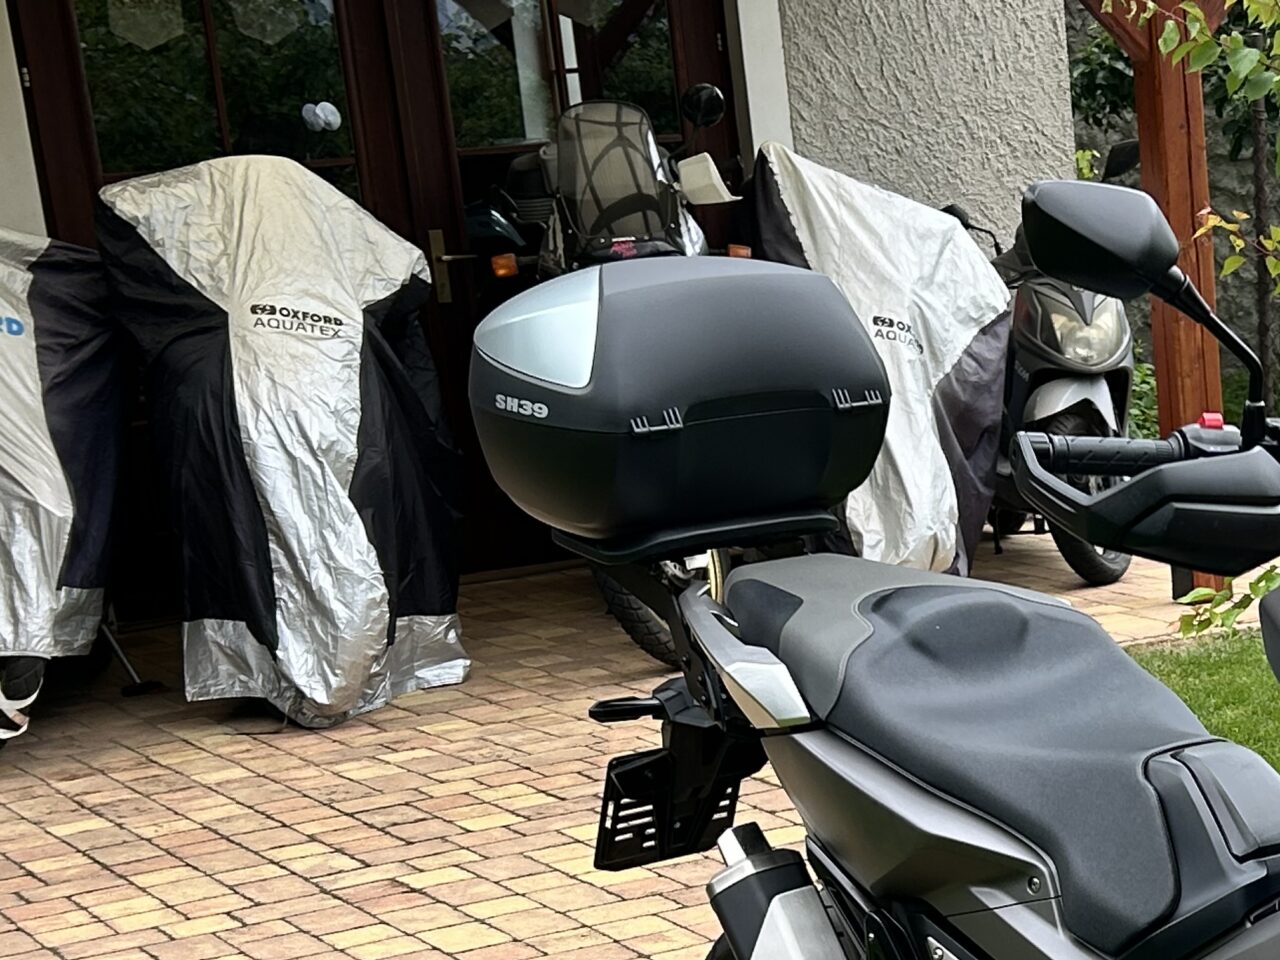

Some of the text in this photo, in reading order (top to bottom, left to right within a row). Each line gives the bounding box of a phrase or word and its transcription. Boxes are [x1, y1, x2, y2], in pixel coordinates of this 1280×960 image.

[279, 307, 344, 326] OXFORD
[253, 317, 342, 338] AQUATEX
[495, 393, 549, 418] SH39
